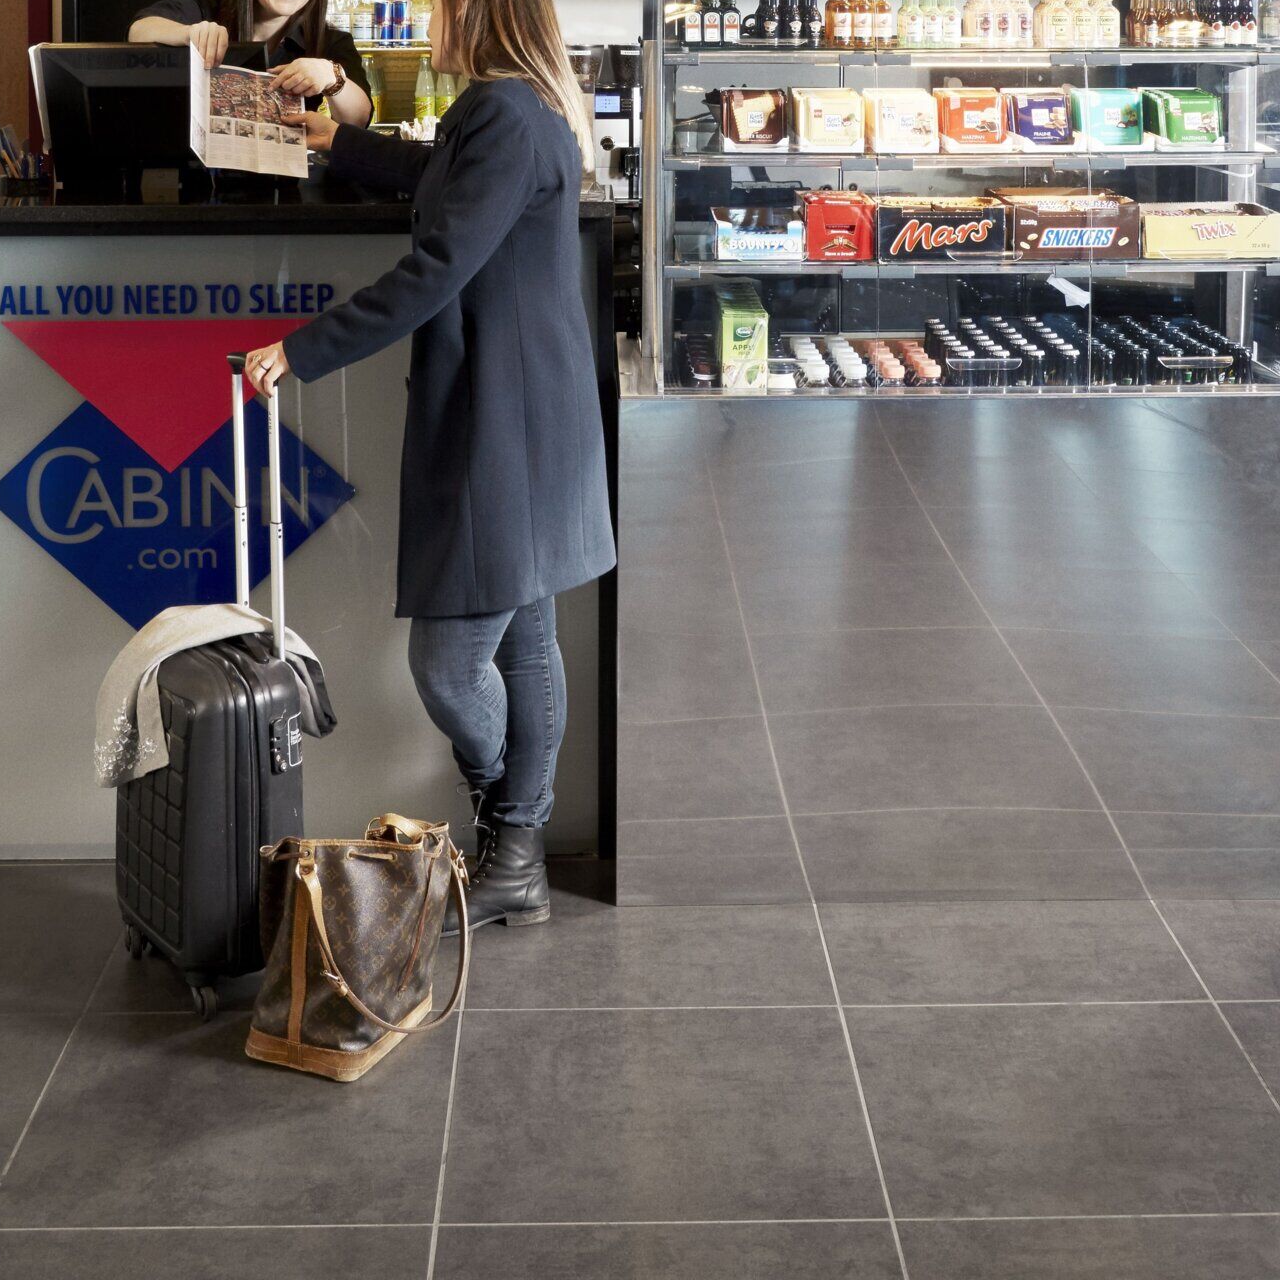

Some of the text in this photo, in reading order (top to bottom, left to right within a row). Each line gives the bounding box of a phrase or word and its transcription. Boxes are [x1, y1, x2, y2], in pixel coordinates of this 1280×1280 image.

[729, 239, 784, 250] BOUNTY
[890, 218, 993, 256] Mars
[1041, 229, 1114, 247] SNICKERS
[56, 284, 114, 316] YOU
[123, 284, 199, 315] NEED
[205, 283, 242, 315] TO
[249, 282, 336, 315] SLEEP
[26, 445, 310, 545] CABINN
[126, 548, 219, 571] .com
